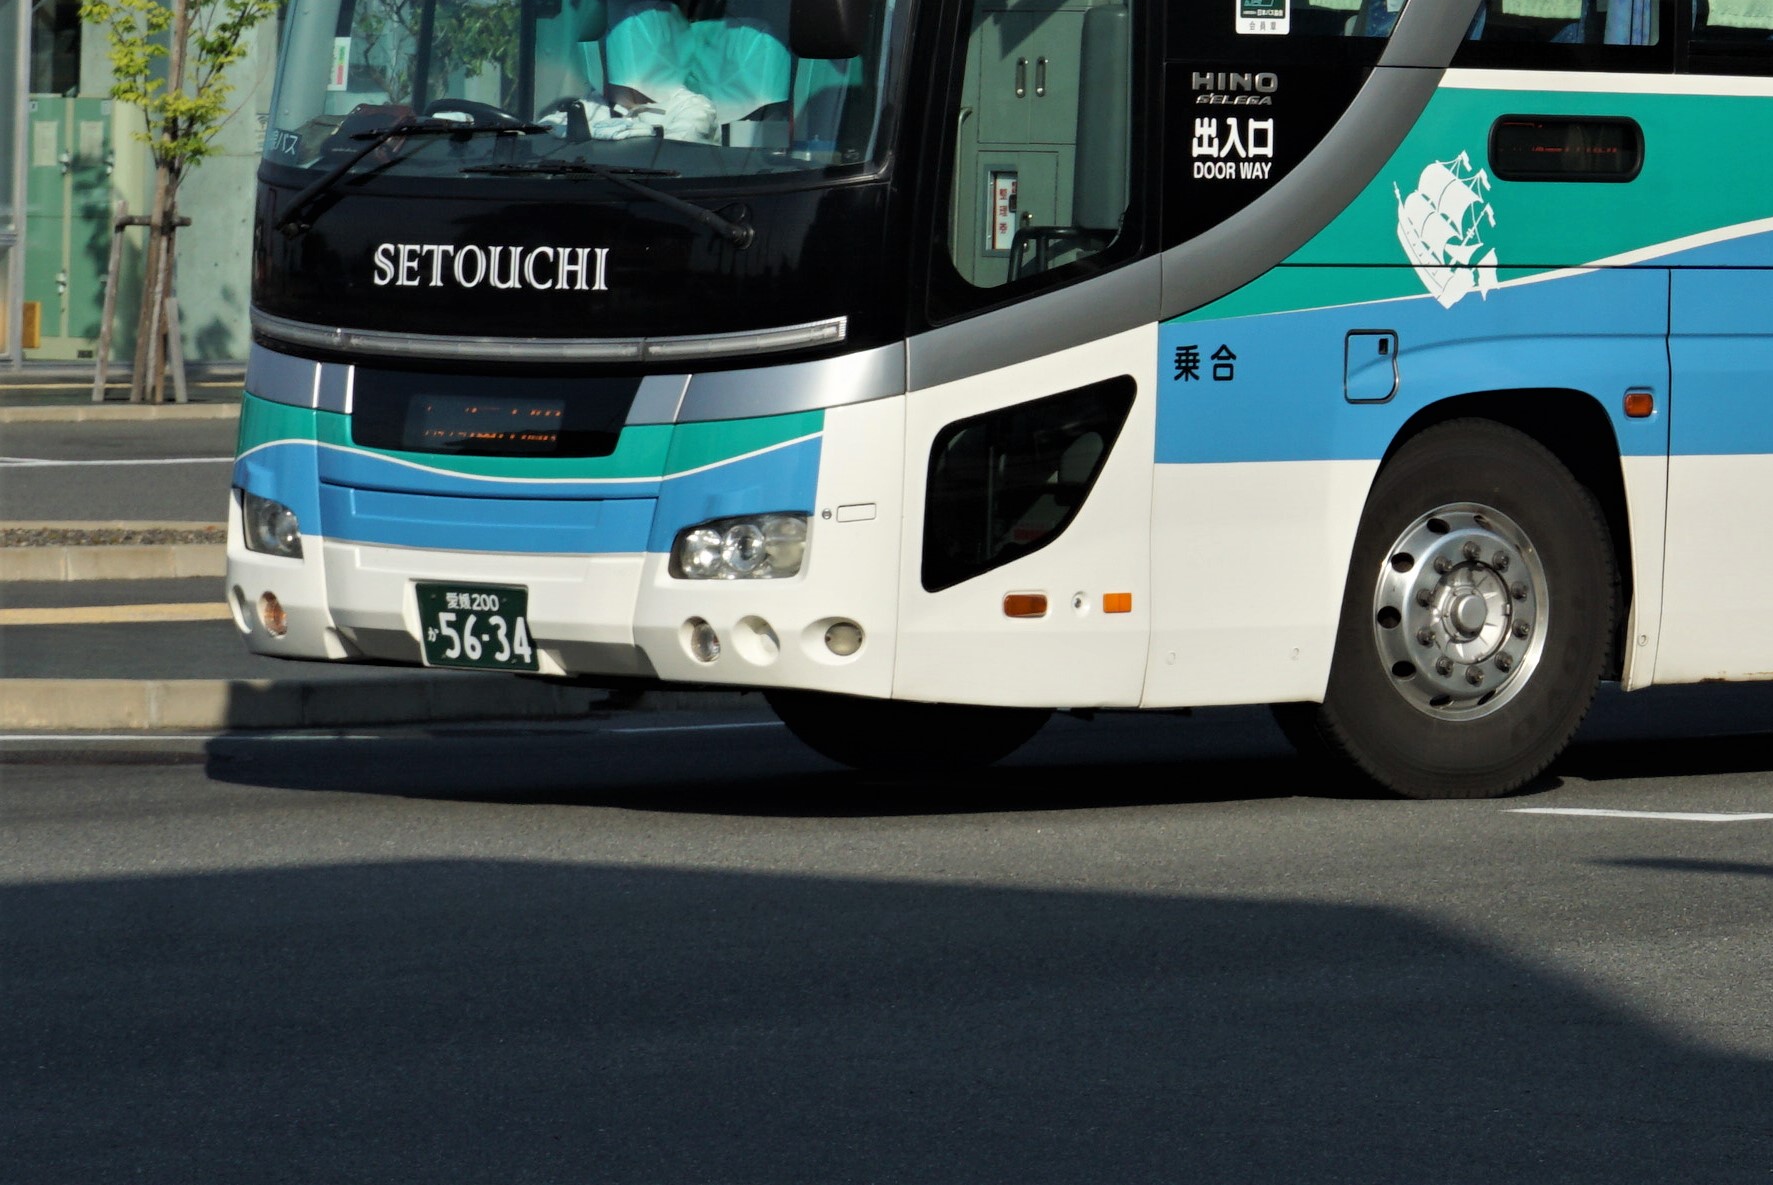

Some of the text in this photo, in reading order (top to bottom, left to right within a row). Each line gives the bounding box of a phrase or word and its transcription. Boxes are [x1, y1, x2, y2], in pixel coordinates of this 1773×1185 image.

[1192, 72, 1278, 92] HINO
[1192, 117, 1274, 158] 出入口
[1193, 161, 1272, 179] DOOR WAY
[374, 243, 610, 291] SETOUCHI
[1174, 344, 1237, 382] 乗合
[438, 612, 532, 663] 56-34
